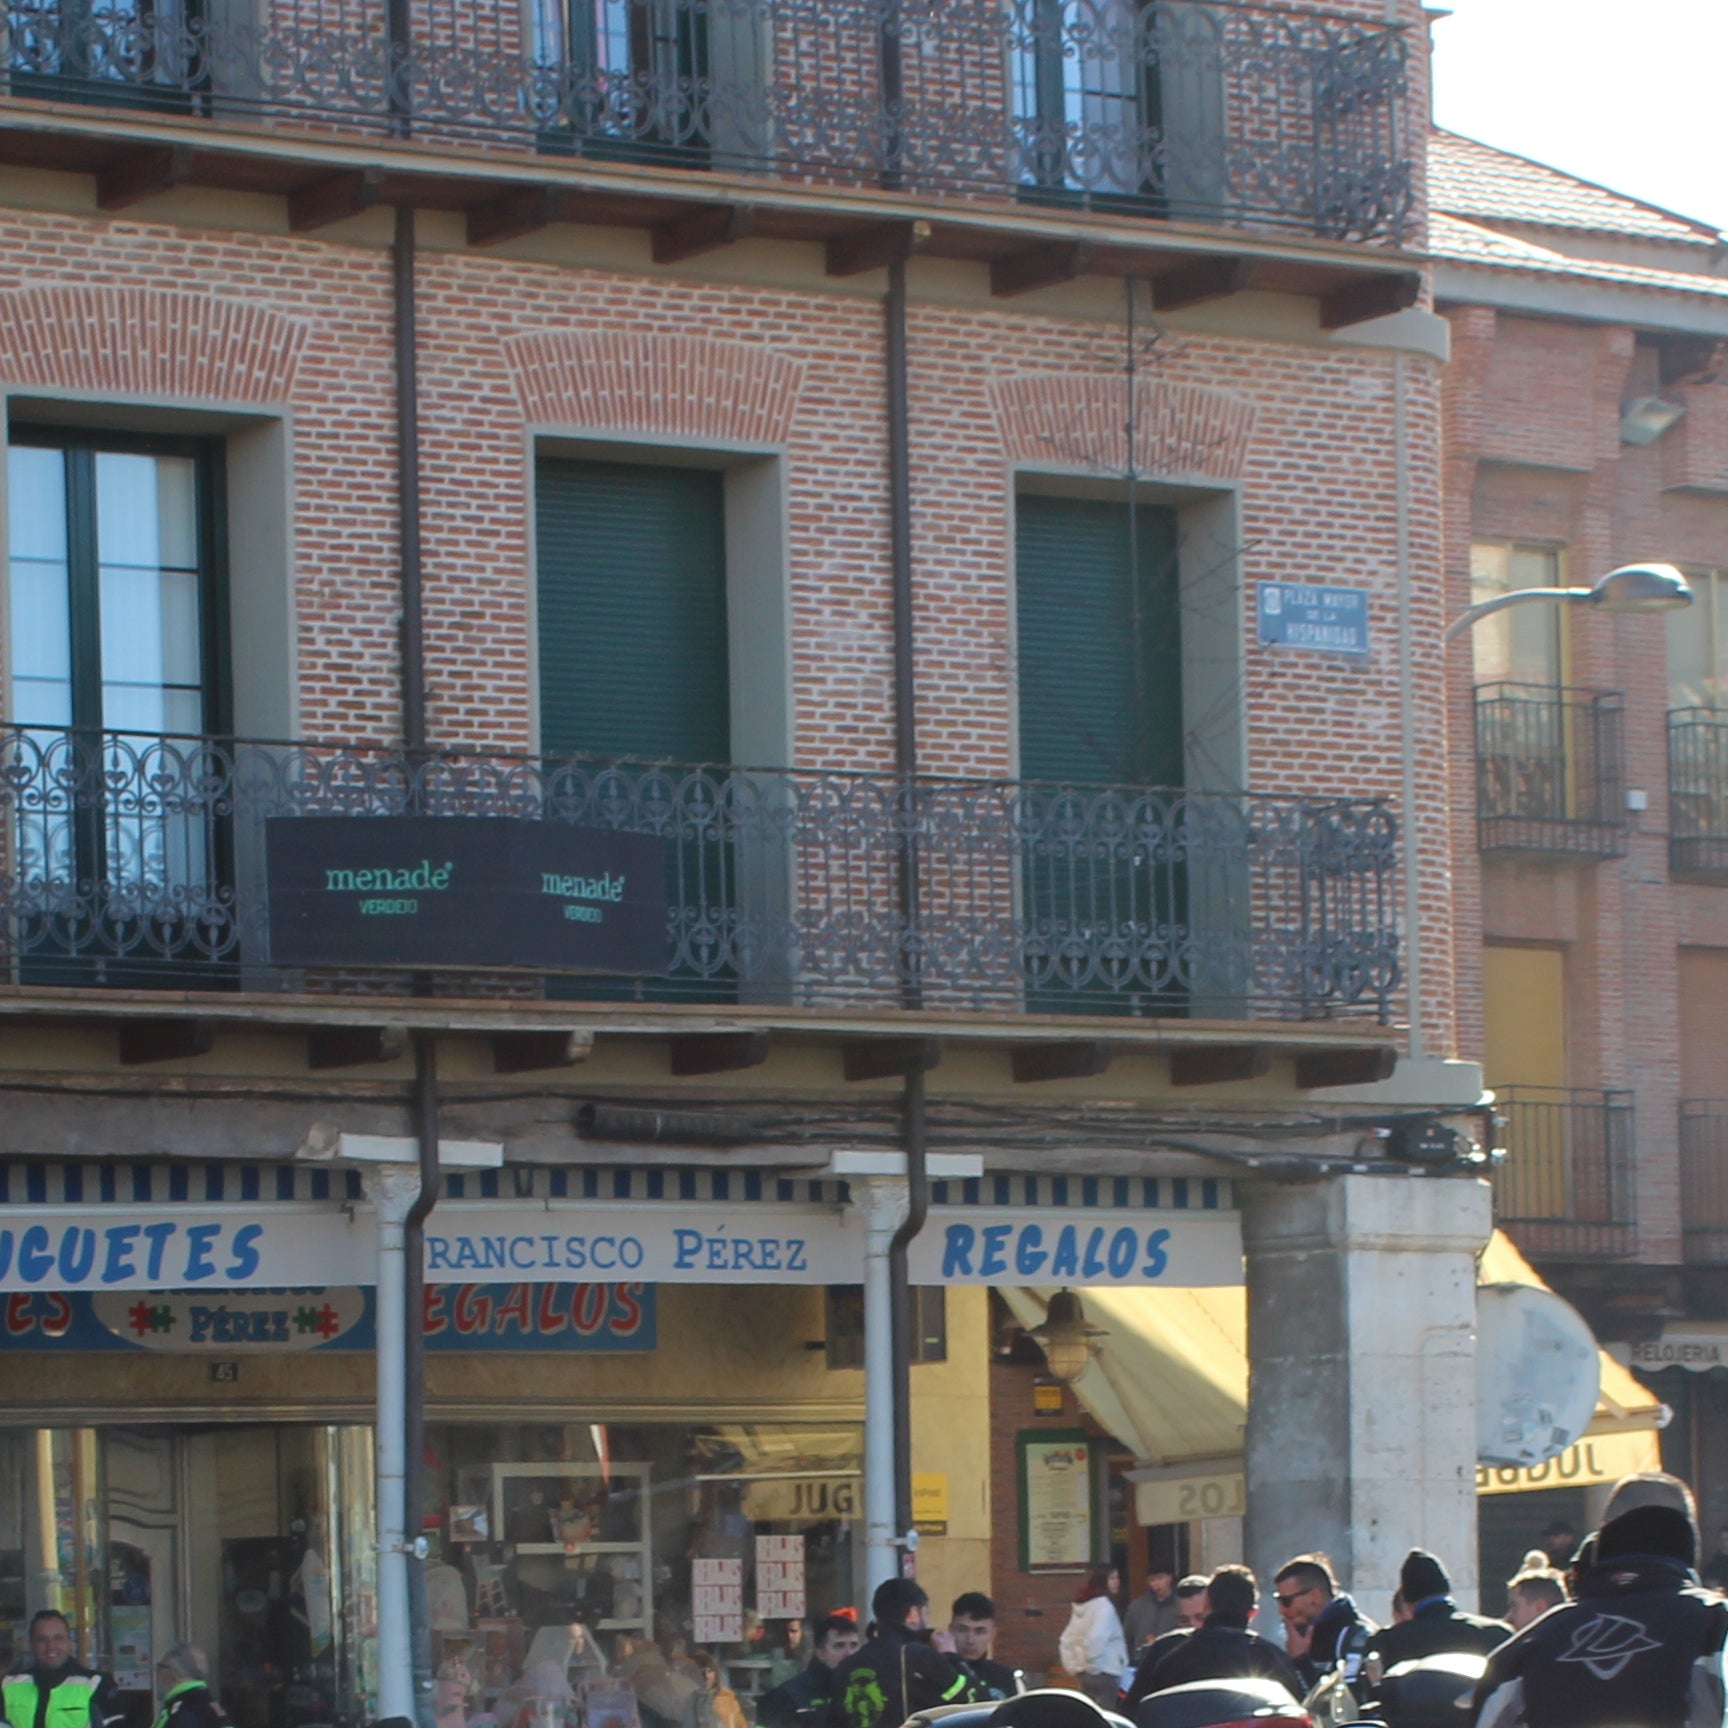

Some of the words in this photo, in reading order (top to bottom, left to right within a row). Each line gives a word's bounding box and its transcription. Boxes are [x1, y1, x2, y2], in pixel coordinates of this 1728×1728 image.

[1283, 588, 1319, 606] PLAZA
[1323, 592, 1360, 608] MAYOR
[1323, 611, 1336, 621] LA
[1286, 622, 1358, 645] HISPANIDAD
[325, 860, 454, 891] menade
[541, 871, 626, 902] menade
[672, 1224, 808, 1272] PÉREZ
[941, 1223, 1172, 1279] REGALOS
[189, 1304, 290, 1343] PÉREZ
[214, 1364, 234, 1381] 45
[789, 1483, 854, 1516] JUG
